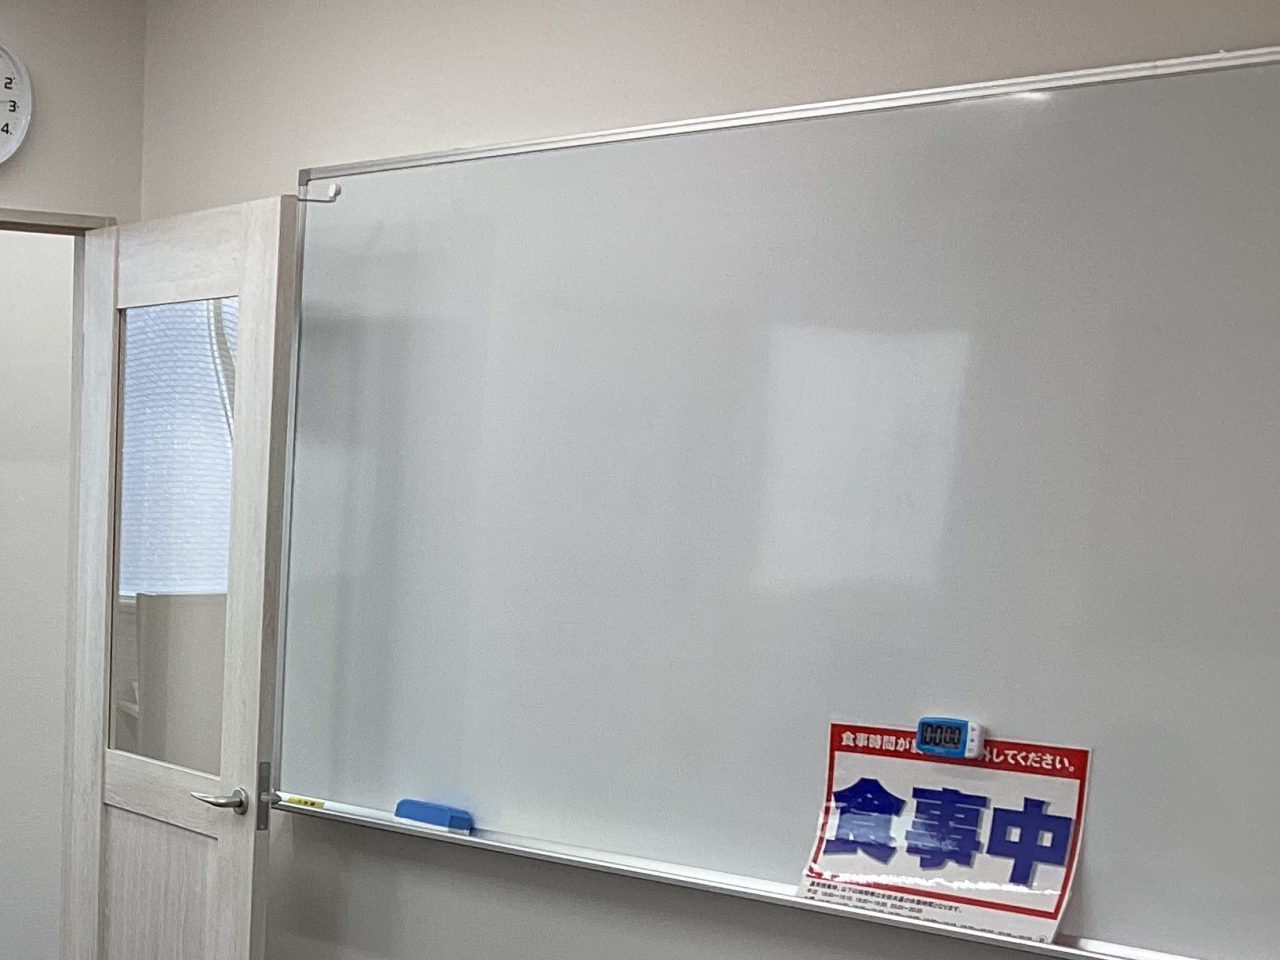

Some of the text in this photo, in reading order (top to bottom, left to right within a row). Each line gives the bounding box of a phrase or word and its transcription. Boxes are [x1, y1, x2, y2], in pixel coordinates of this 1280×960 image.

[4, 76, 13, 90] 2
[8, 100, 17, 112] 3
[0, 122, 10, 135] 4
[823, 777, 1073, 886] 食事中
